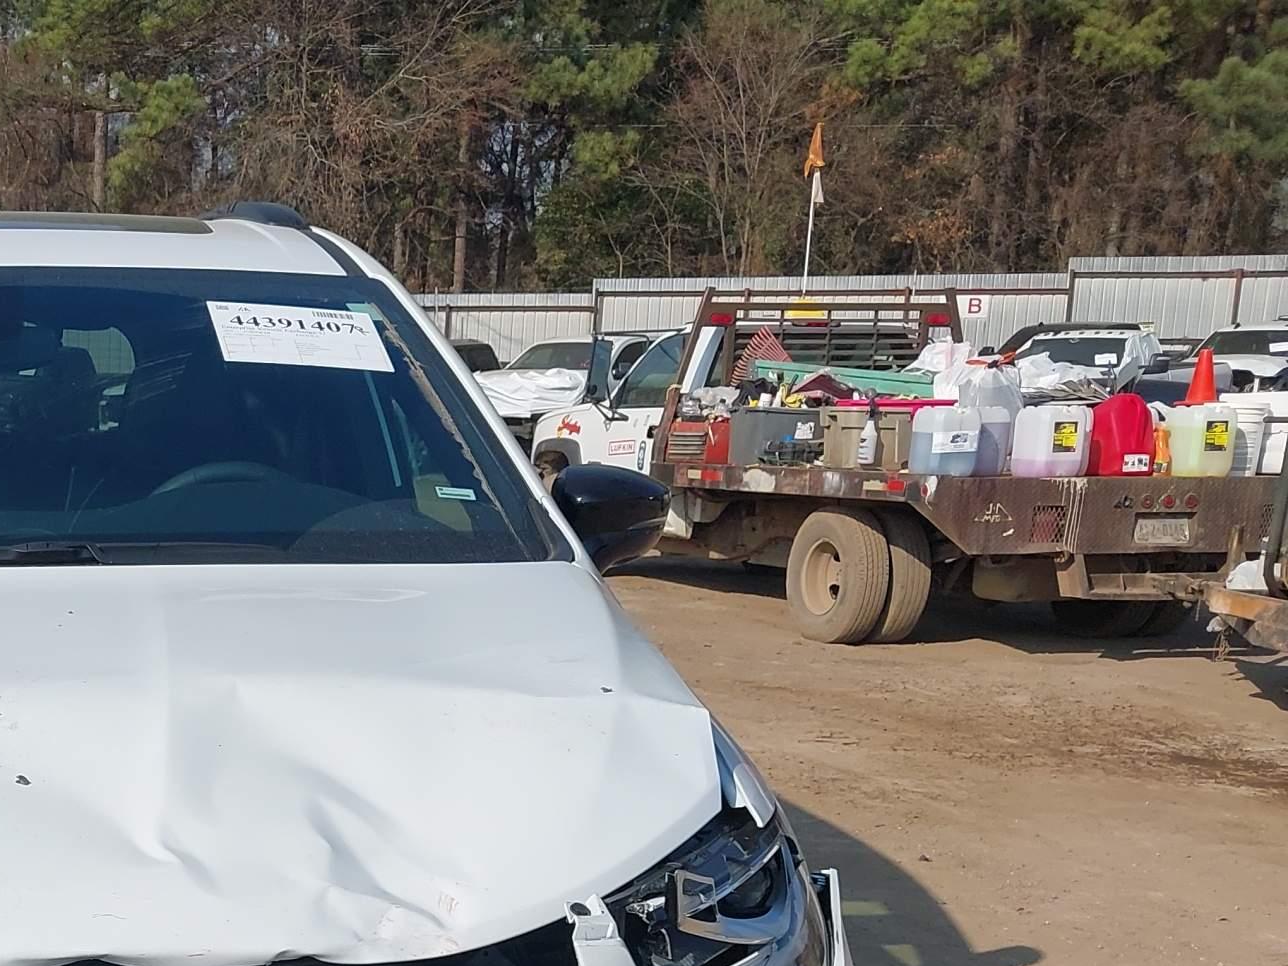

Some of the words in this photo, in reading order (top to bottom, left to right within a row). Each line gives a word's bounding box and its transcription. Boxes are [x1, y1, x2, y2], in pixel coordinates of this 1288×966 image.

[967, 297, 982, 314] B
[229, 315, 354, 334] 44391407
[610, 443, 633, 453] LUFKIN
